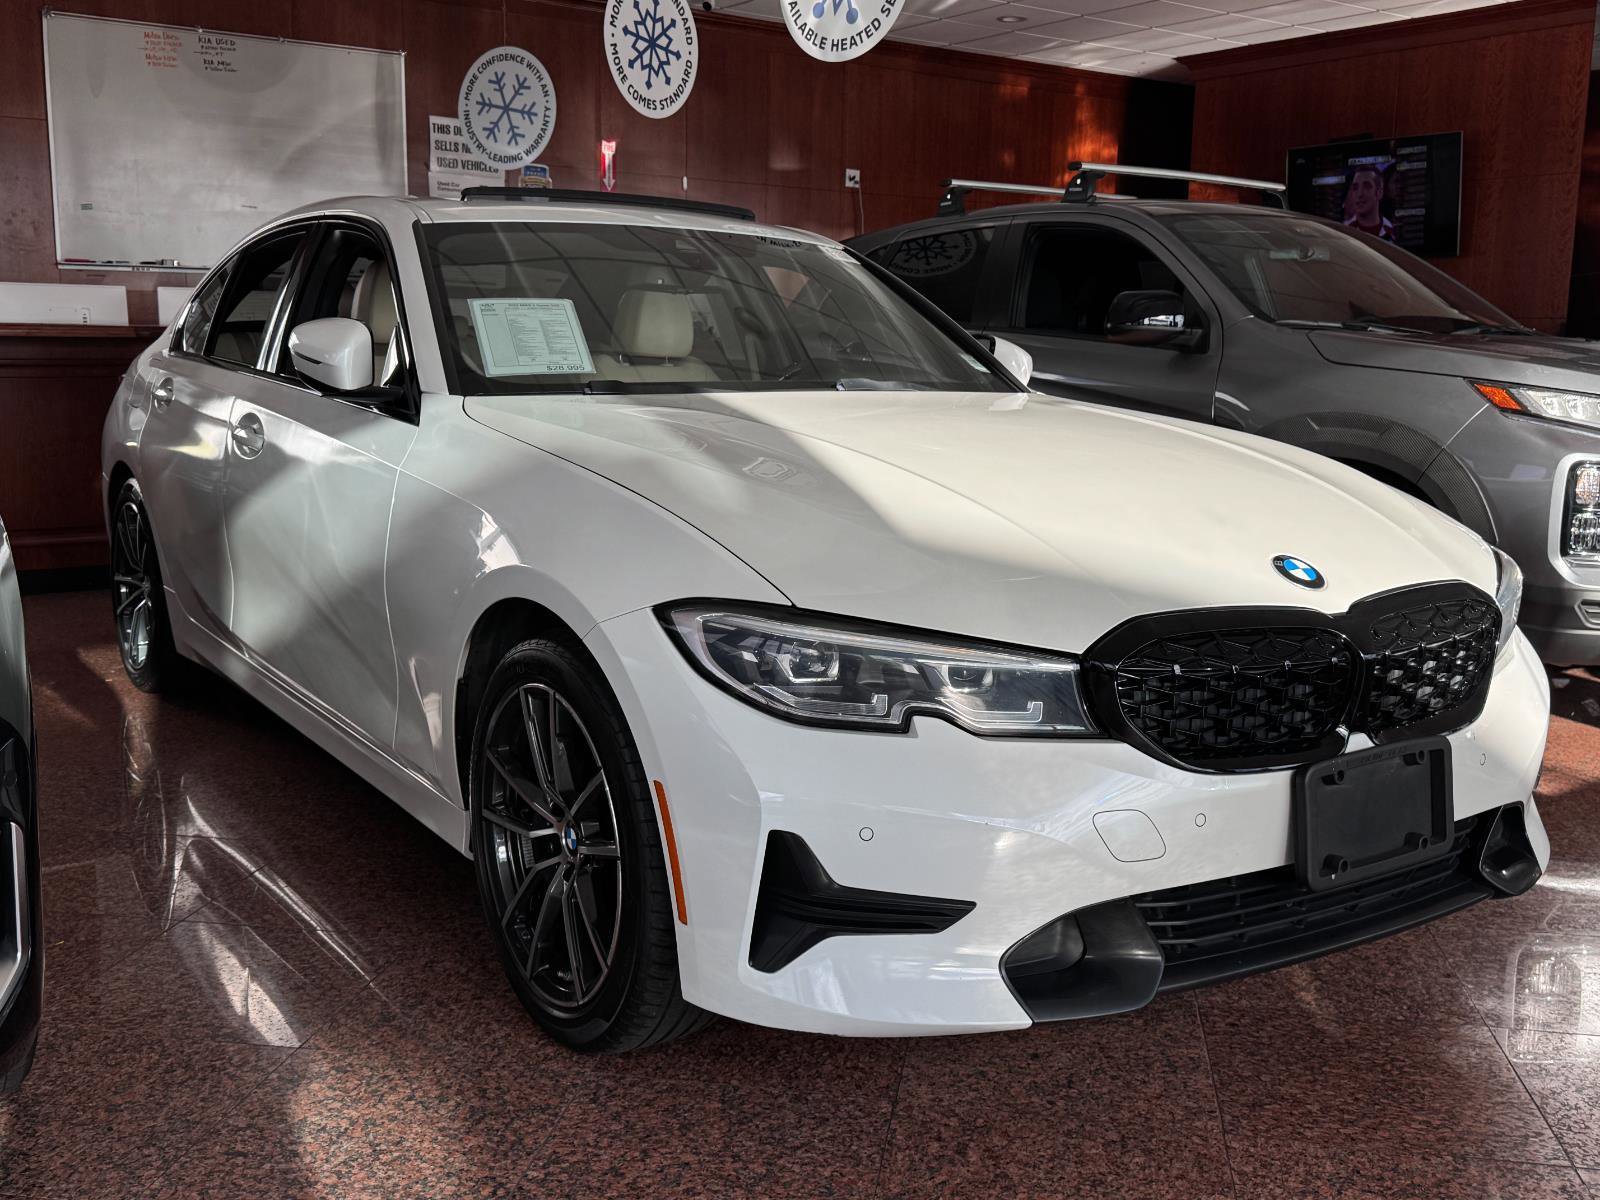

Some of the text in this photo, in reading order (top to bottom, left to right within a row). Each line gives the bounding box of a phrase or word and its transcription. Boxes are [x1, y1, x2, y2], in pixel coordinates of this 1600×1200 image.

[830, 17, 882, 52] HEATED
[464, 53, 550, 101] MORE CONFIDENCE WITH AN
[610, 43, 693, 111] MORE COMES STANDARD
[432, 123, 451, 135] THIS
[434, 140, 459, 153] SELLS
[463, 105, 552, 164] INDUSTRY-LEADING WARRANTY
[437, 156, 458, 169] USED
